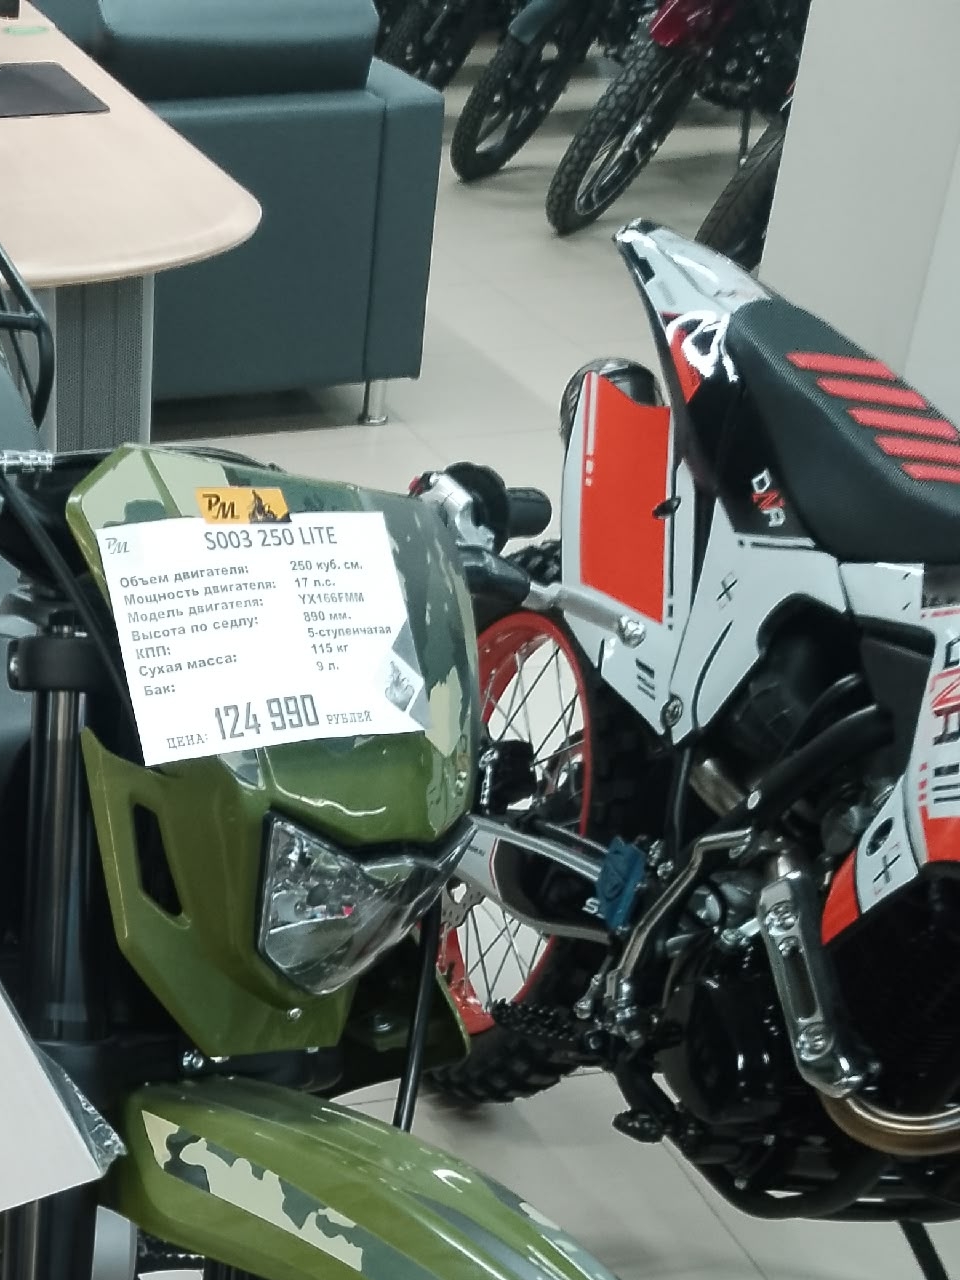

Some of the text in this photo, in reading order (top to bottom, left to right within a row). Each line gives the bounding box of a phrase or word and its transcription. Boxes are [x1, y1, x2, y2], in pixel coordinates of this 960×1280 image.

[204, 526, 338, 550] S003 250 LITE
[119, 559, 363, 588] Объем двигателя: 250 куб. см.
[123, 589, 200, 606] Мощность
[203, 580, 277, 596] двигателя:
[294, 577, 308, 588] 17
[127, 607, 184, 623] Модель
[188, 598, 264, 616] двигателя:
[131, 610, 352, 642] Высота по седлу: 890 мм.
[135, 626, 392, 660] КПП: 5-ступенчатая
[138, 642, 349, 678] Сухая масса: 115 кг
[143, 683, 176, 697] Бак:
[316, 661, 324, 671] 9
[166, 694, 373, 749] ЦЕНА: 124 990 РУБЛЕЙ
